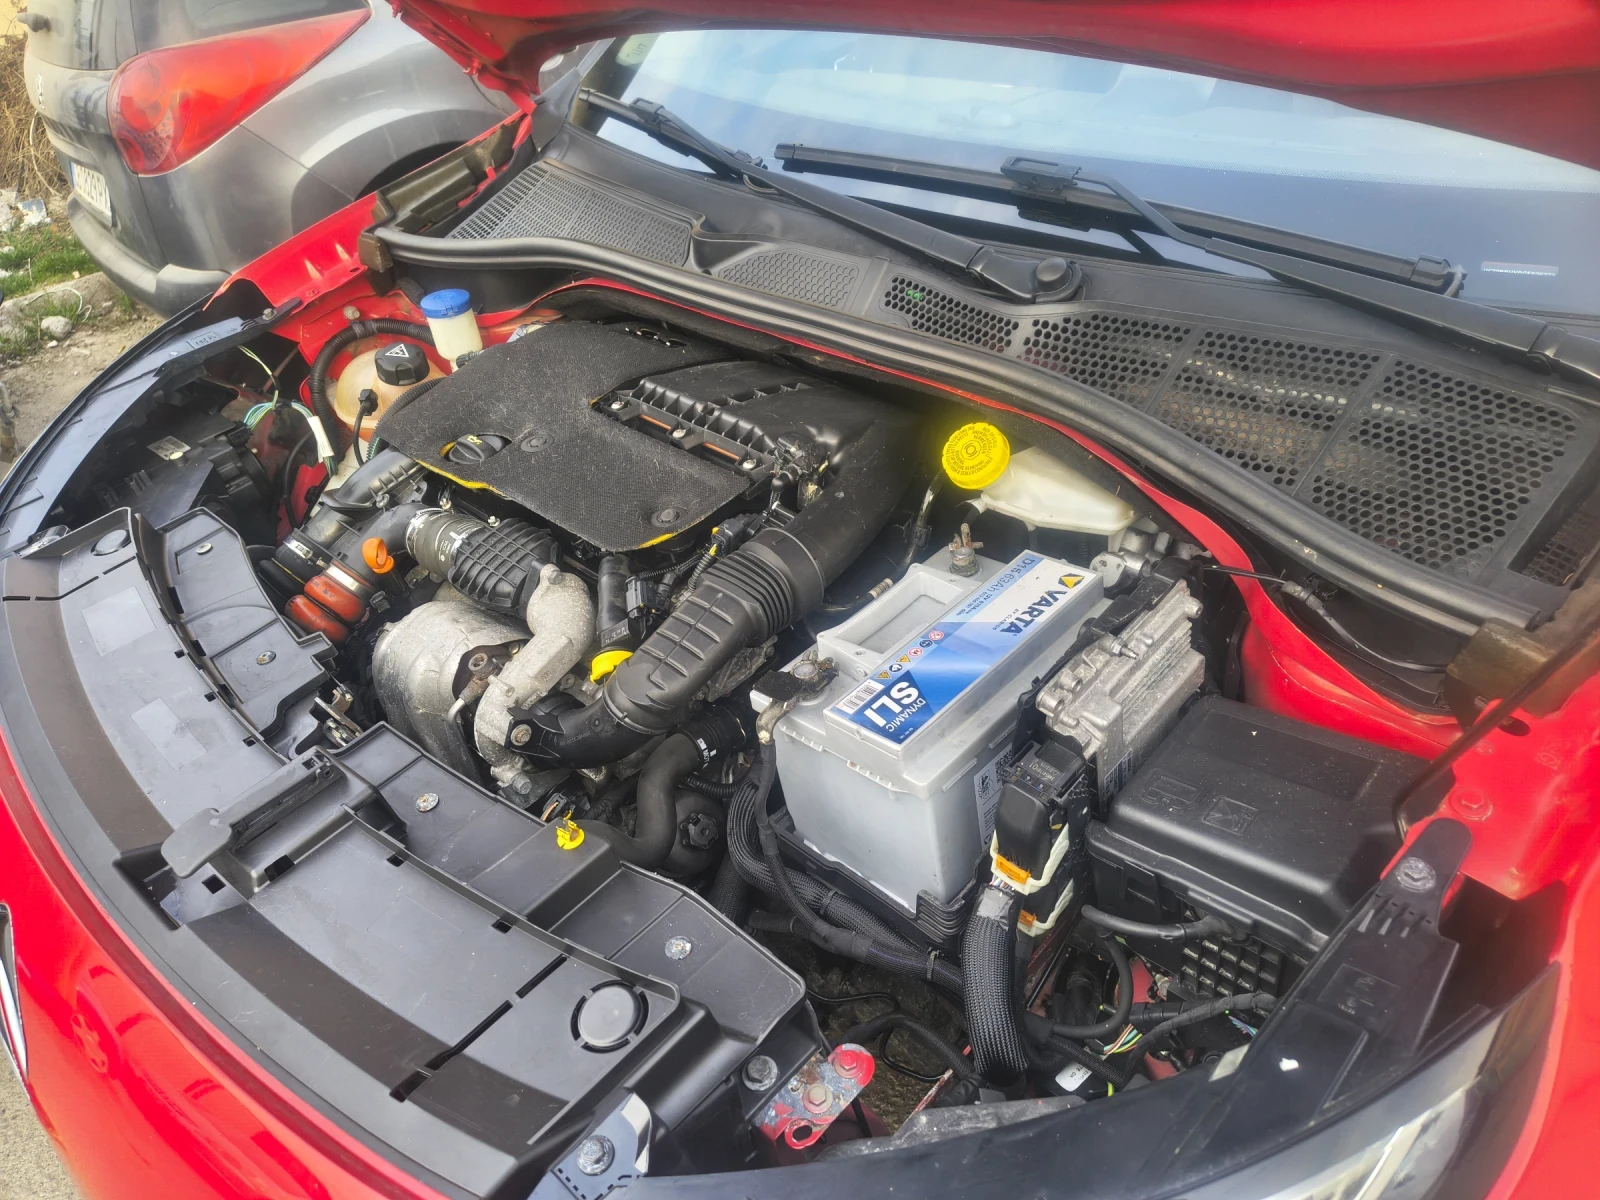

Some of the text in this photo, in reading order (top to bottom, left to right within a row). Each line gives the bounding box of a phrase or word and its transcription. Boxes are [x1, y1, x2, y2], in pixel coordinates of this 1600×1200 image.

[987, 573, 1015, 592] 63Ah
[1000, 590, 1068, 634] VARTA
[863, 681, 919, 727] SLI
[886, 698, 926, 732] DYNAMIC
